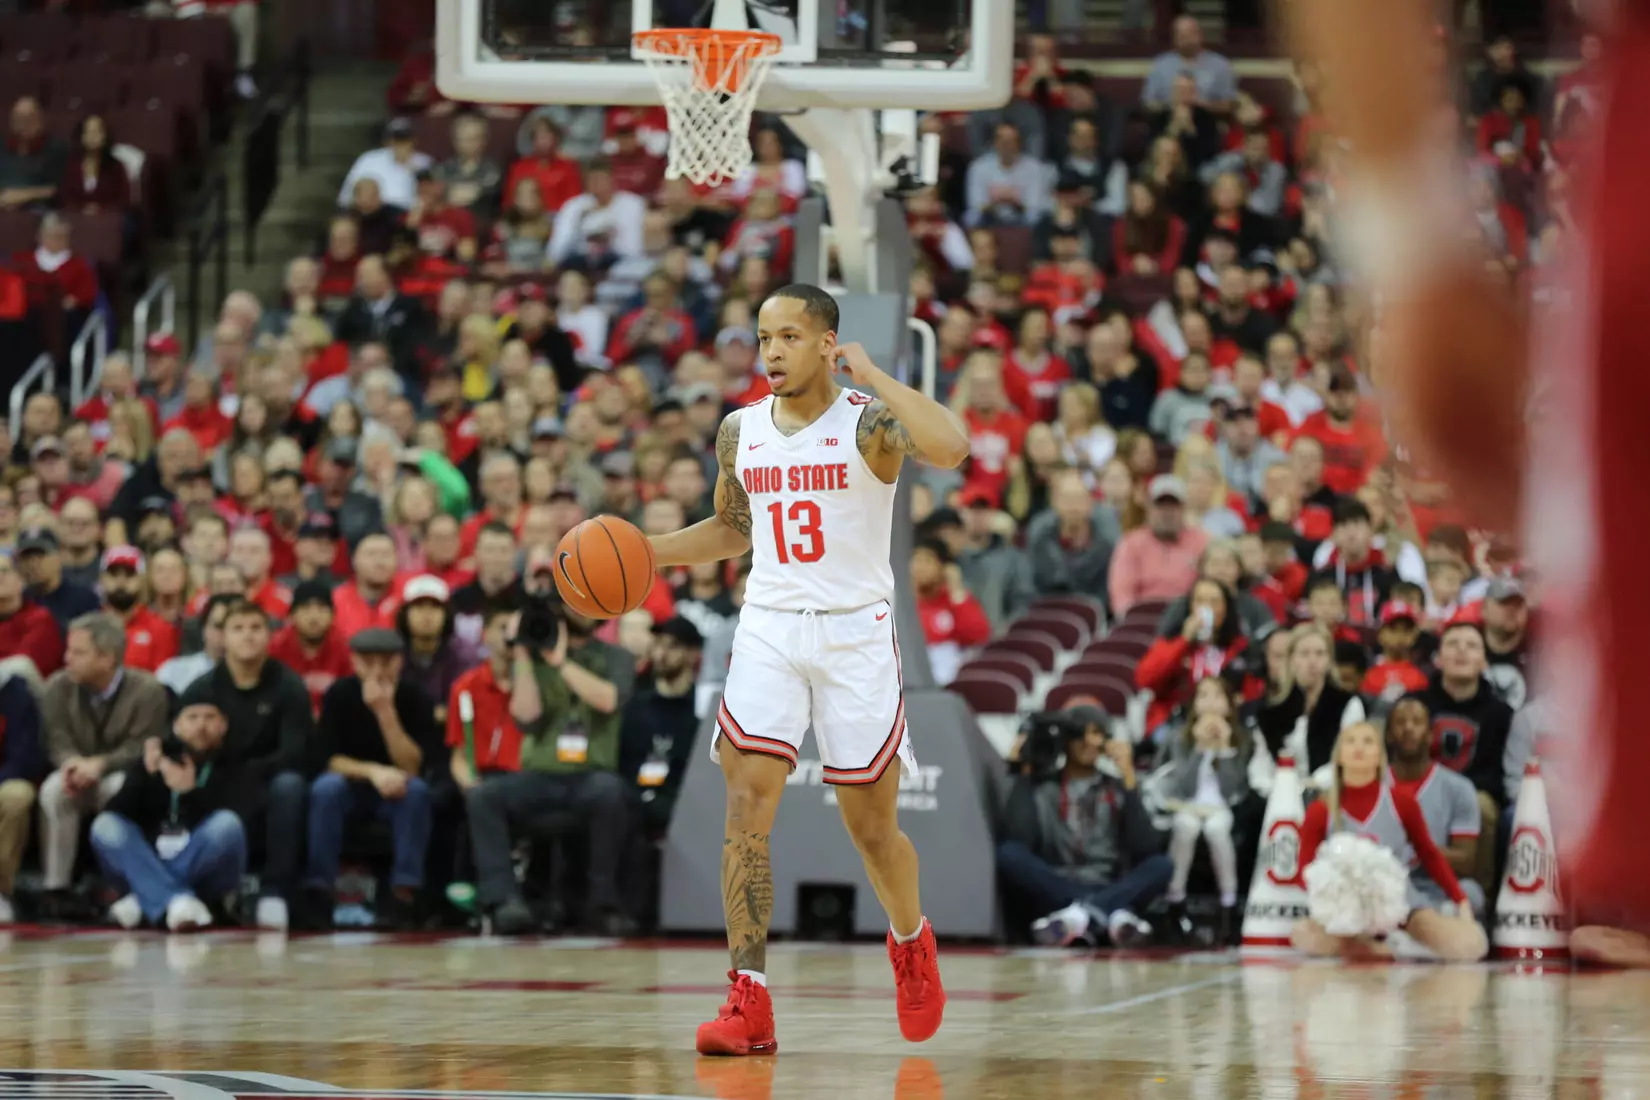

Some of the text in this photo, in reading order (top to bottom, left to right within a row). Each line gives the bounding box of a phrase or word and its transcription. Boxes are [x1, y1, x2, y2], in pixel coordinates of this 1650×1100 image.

[743, 463, 848, 493] OHIO STATE
[767, 500, 826, 564] 13
